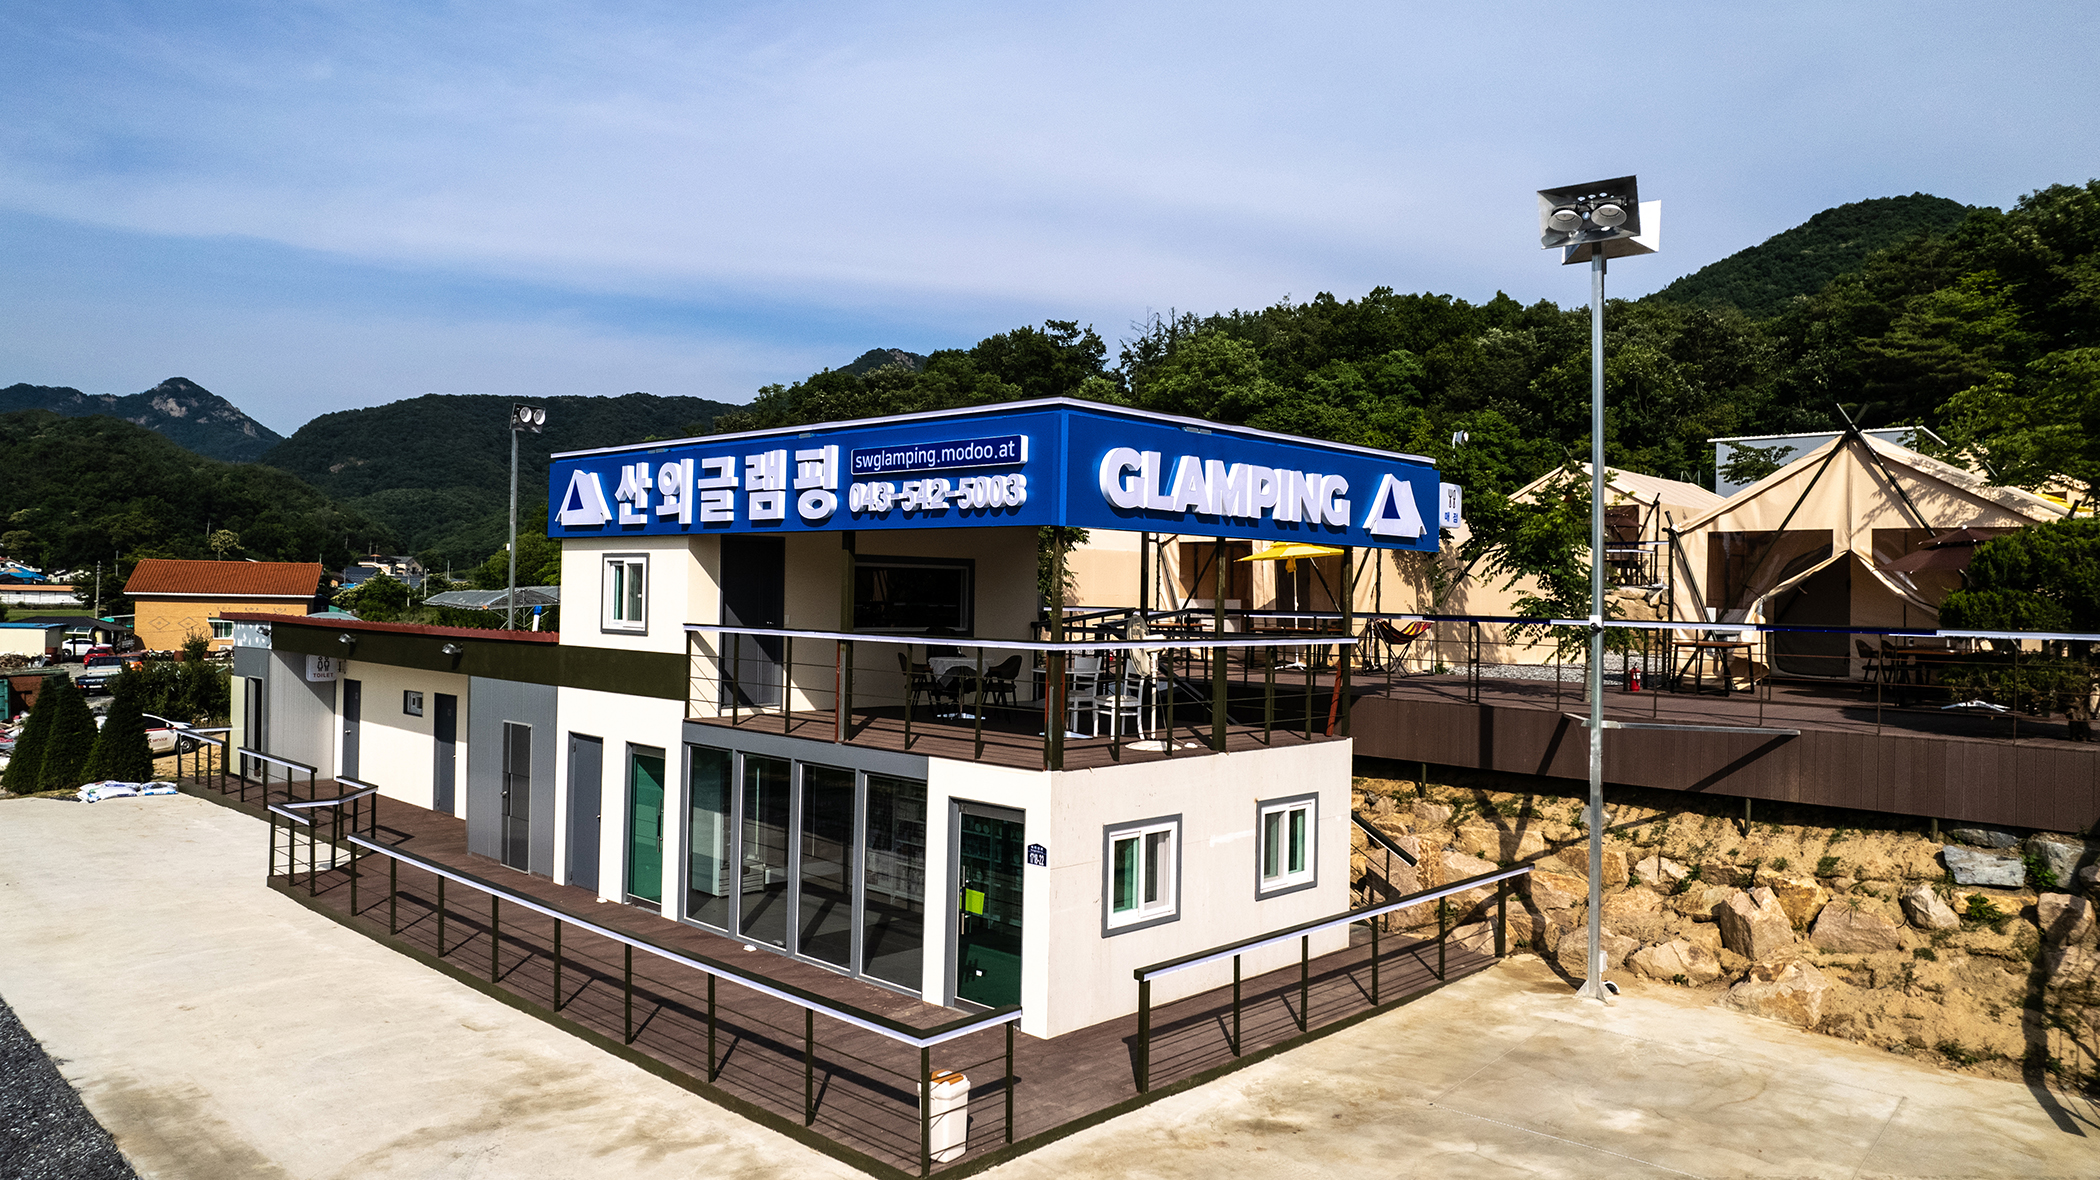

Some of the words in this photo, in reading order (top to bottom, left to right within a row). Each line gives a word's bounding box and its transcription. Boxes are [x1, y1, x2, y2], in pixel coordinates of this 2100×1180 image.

[615, 445, 839, 525] 산외글램핑
[855, 440, 1015, 471] swglamping.modoo.at
[849, 473, 1027, 512] 043-542-5003
[1099, 447, 1351, 527] GLAMPING
